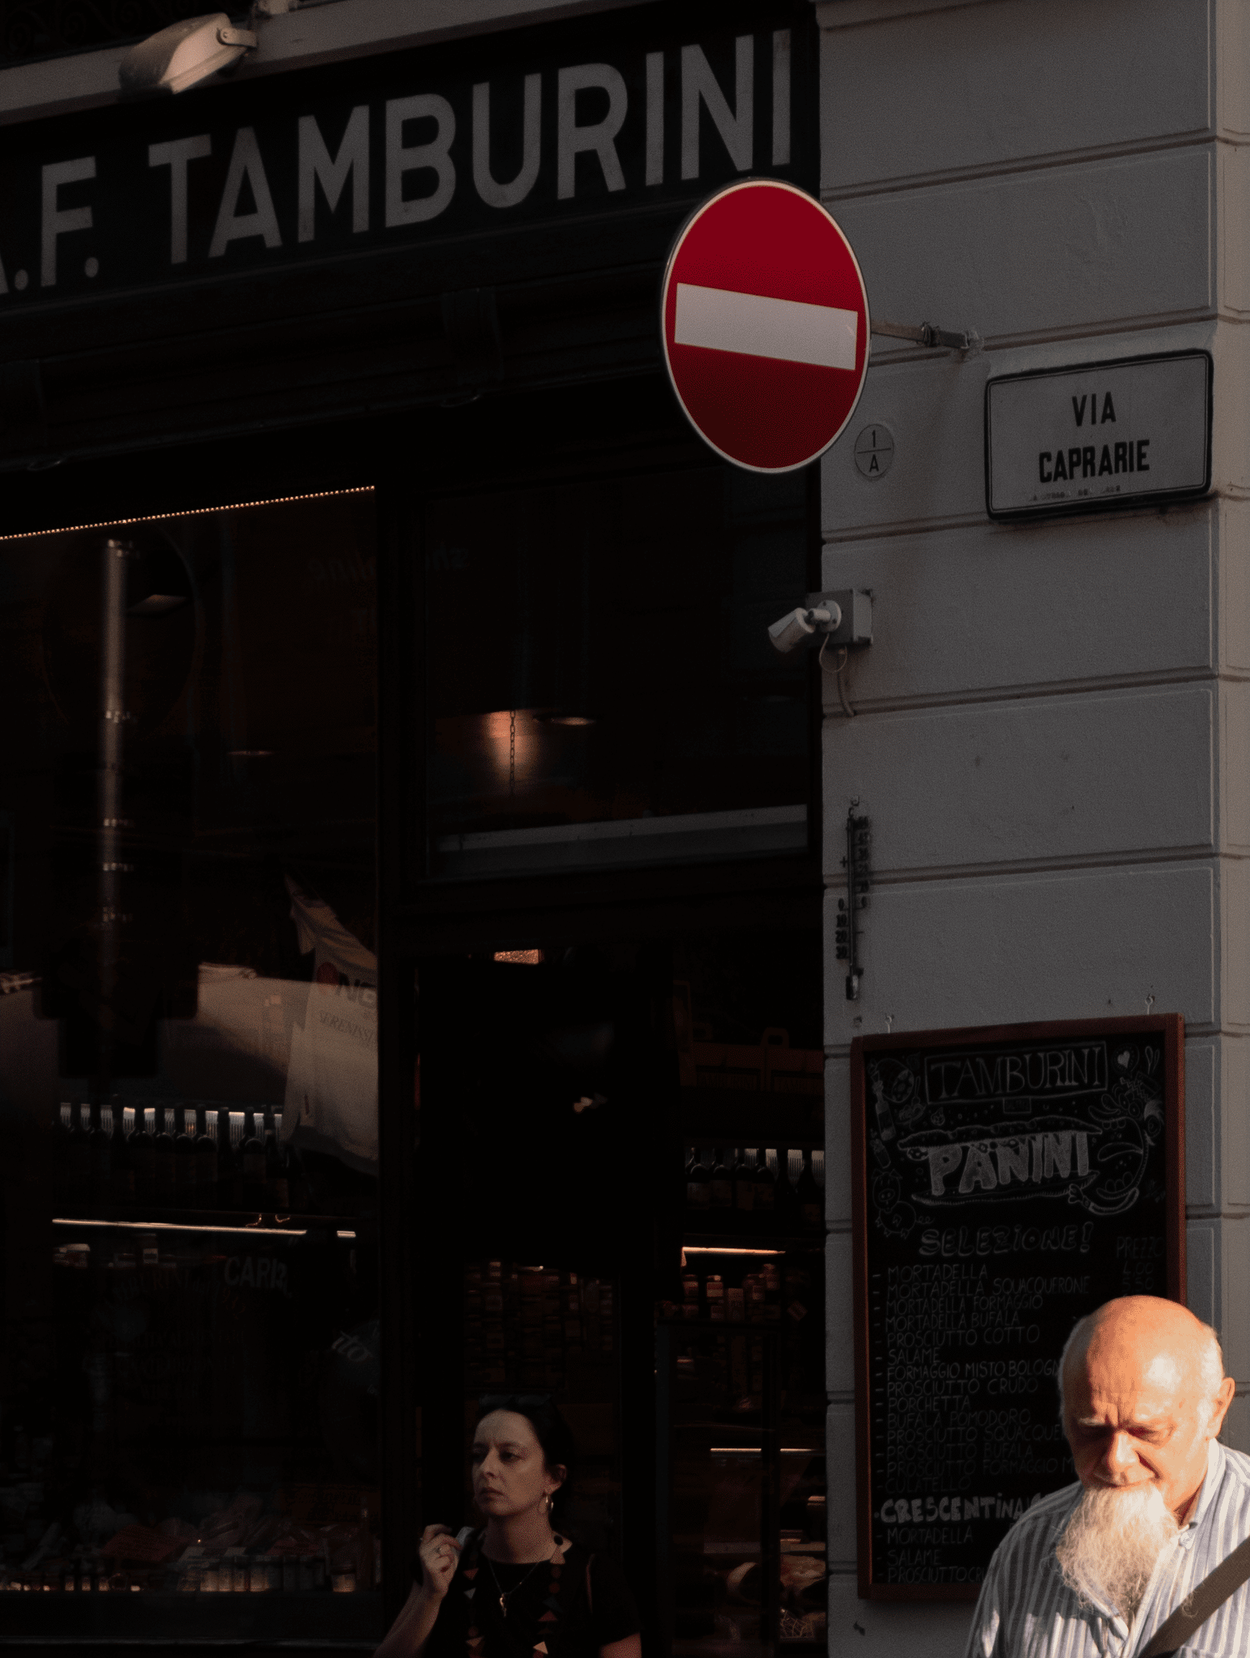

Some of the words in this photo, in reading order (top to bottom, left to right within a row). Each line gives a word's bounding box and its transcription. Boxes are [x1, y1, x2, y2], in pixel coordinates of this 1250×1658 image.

[0, 156, 99, 294] .F.
[147, 28, 793, 265] TAMBURINI
[1072, 391, 1116, 428] VIA
[1038, 439, 1150, 483] CAPRARIE
[931, 1047, 1101, 1099] TAMBURINI
[927, 1131, 1090, 1196] PANINI
[1115, 1236, 1165, 1260] PREZZO
[887, 1263, 988, 1283] MORTADELLA
[887, 1280, 985, 1300] MORTADELLA
[992, 1275, 1091, 1297] SQUACQUERONE
[886, 1298, 966, 1316] MORTADELLA
[973, 1294, 1044, 1311] FORMAGGIO
[885, 1313, 967, 1332] MORTADELLA
[971, 1310, 1020, 1328] BUFALA
[887, 1328, 978, 1348] PROSCIUTTO
[983, 1323, 1040, 1345] COTTO
[887, 1346, 941, 1365] SALAME
[886, 1361, 961, 1381] FORMAGGIO
[965, 1360, 1006, 1379] MISTO
[886, 1377, 981, 1397] PROSCIUTTO
[987, 1377, 1039, 1395] CRUDO
[887, 1394, 972, 1413] PORCHETTA
[887, 1411, 943, 1430] BUFALA
[949, 1407, 1031, 1427] POMODORO
[887, 1426, 978, 1444] PROSCIUTTO
[886, 1442, 978, 1462] PROSCIUTTO
[983, 1442, 1034, 1459] BUFALA
[886, 1459, 977, 1478] PROSCIUTTO
[983, 1457, 1059, 1476] FORMAGGIO
[885, 1475, 972, 1494] CULATELLO
[886, 1525, 974, 1545] MORTADELLA
[886, 1548, 942, 1567] SALAME
